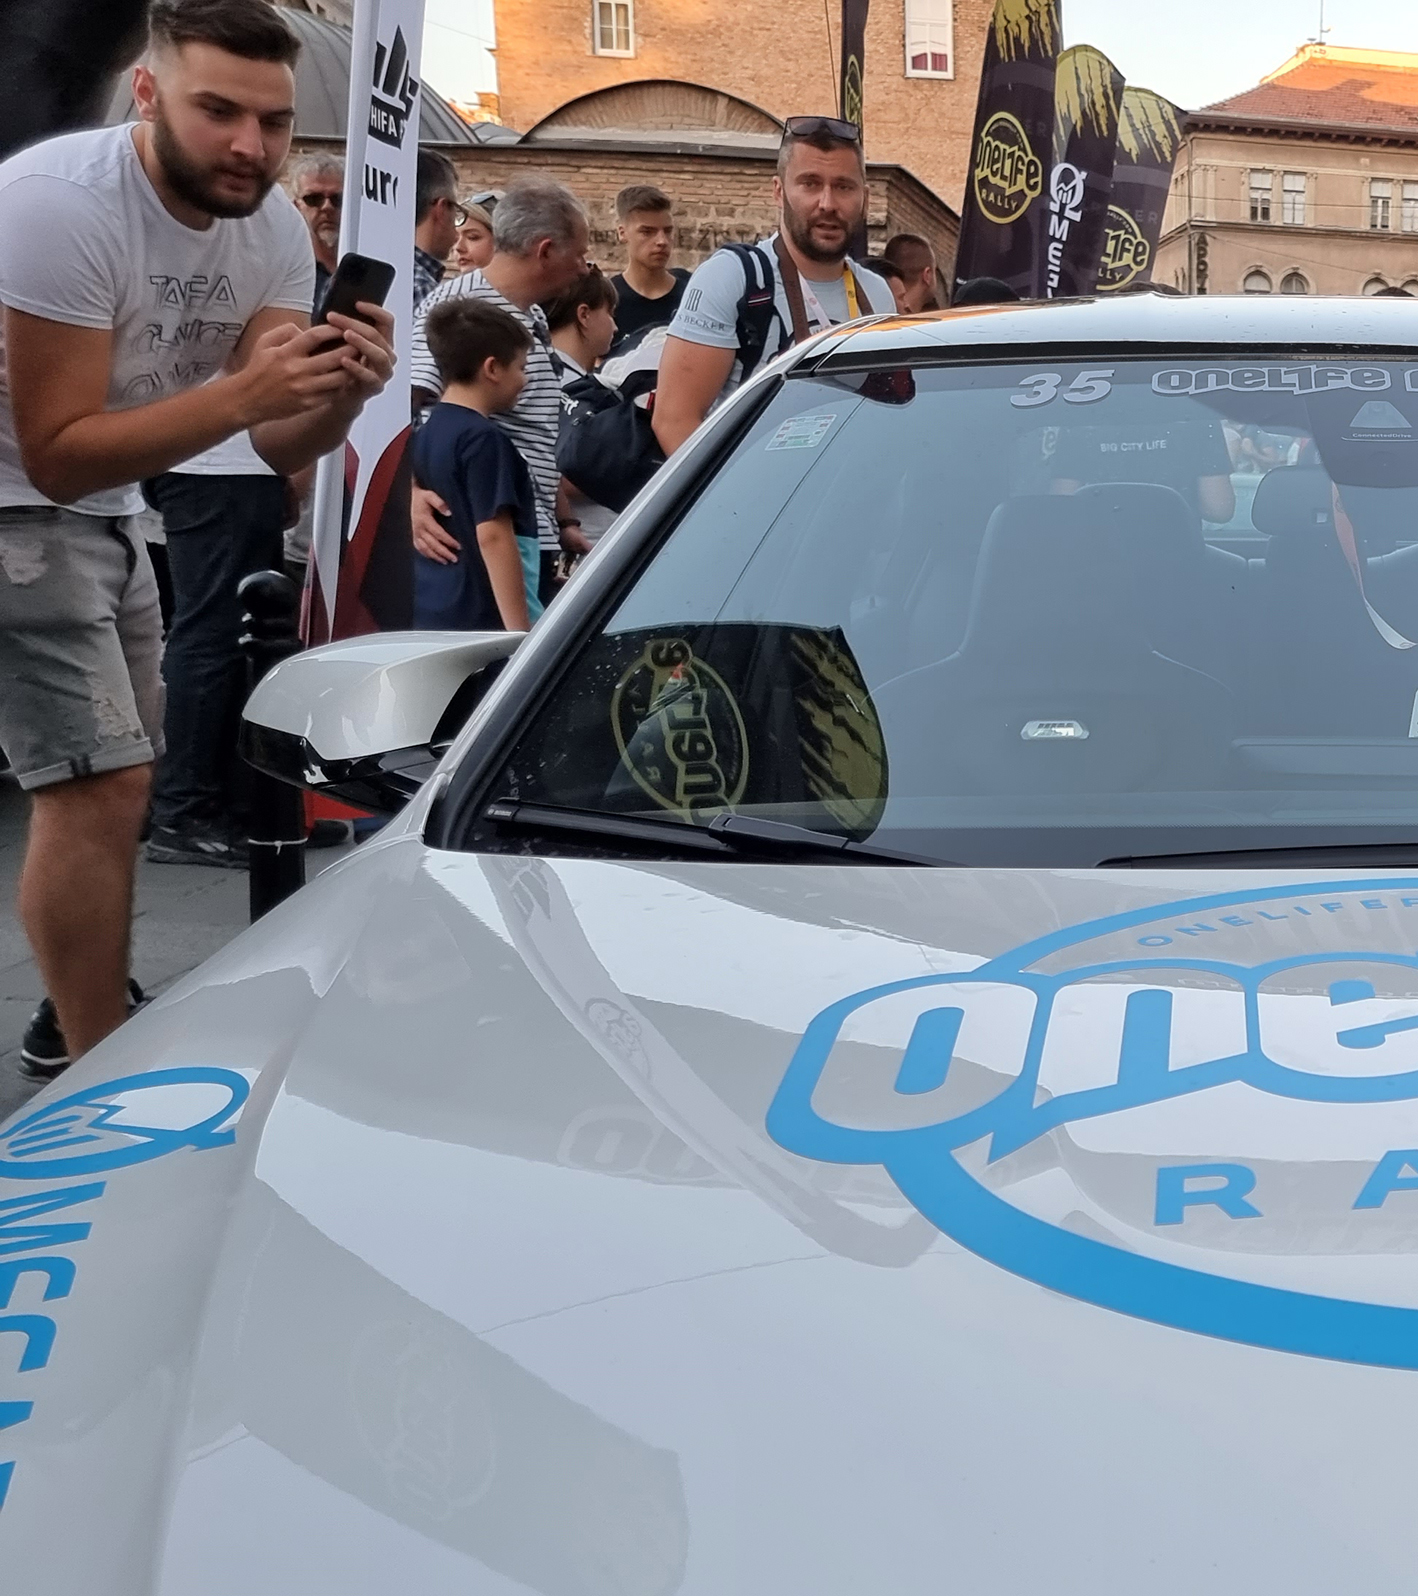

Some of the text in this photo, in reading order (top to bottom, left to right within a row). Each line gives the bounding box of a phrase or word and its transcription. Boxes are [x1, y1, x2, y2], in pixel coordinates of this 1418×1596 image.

[370, 103, 398, 138] HIFA
[981, 188, 1018, 211] RALLY
[685, 313, 726, 332] BECKER
[1010, 369, 1116, 407] 35
[1100, 439, 1167, 452] BIG CITY LIFE
